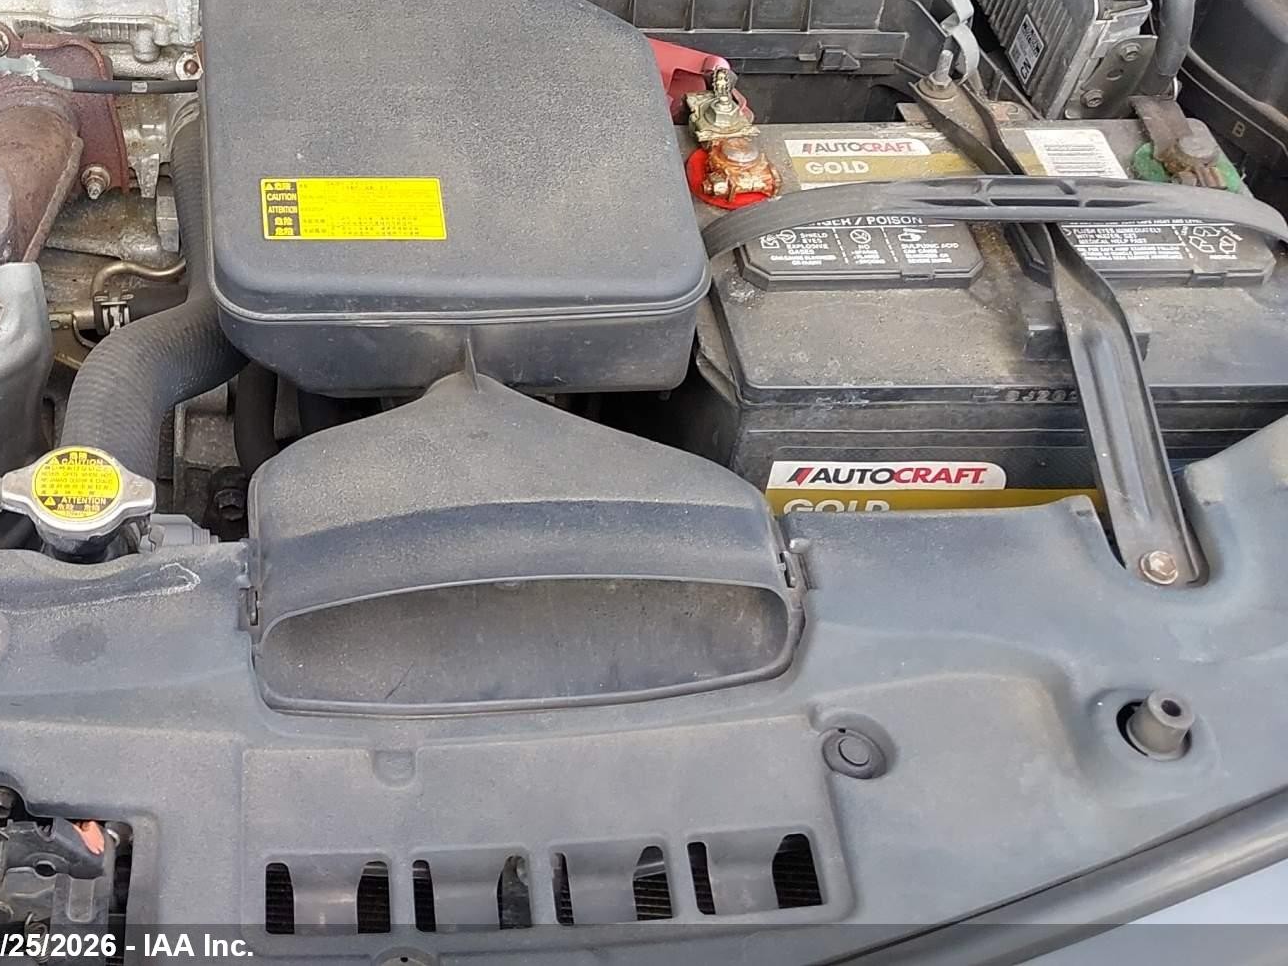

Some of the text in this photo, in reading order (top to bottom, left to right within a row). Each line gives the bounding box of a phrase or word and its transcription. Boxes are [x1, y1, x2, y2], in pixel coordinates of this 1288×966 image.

[814, 141, 914, 153] AUTOCRAFT
[805, 160, 870, 174] GOLD
[267, 193, 297, 201] CAUTION
[866, 215, 923, 225] POISON
[808, 467, 987, 484] AUTOCRAFT
[61, 496, 107, 505] ATTENTION
